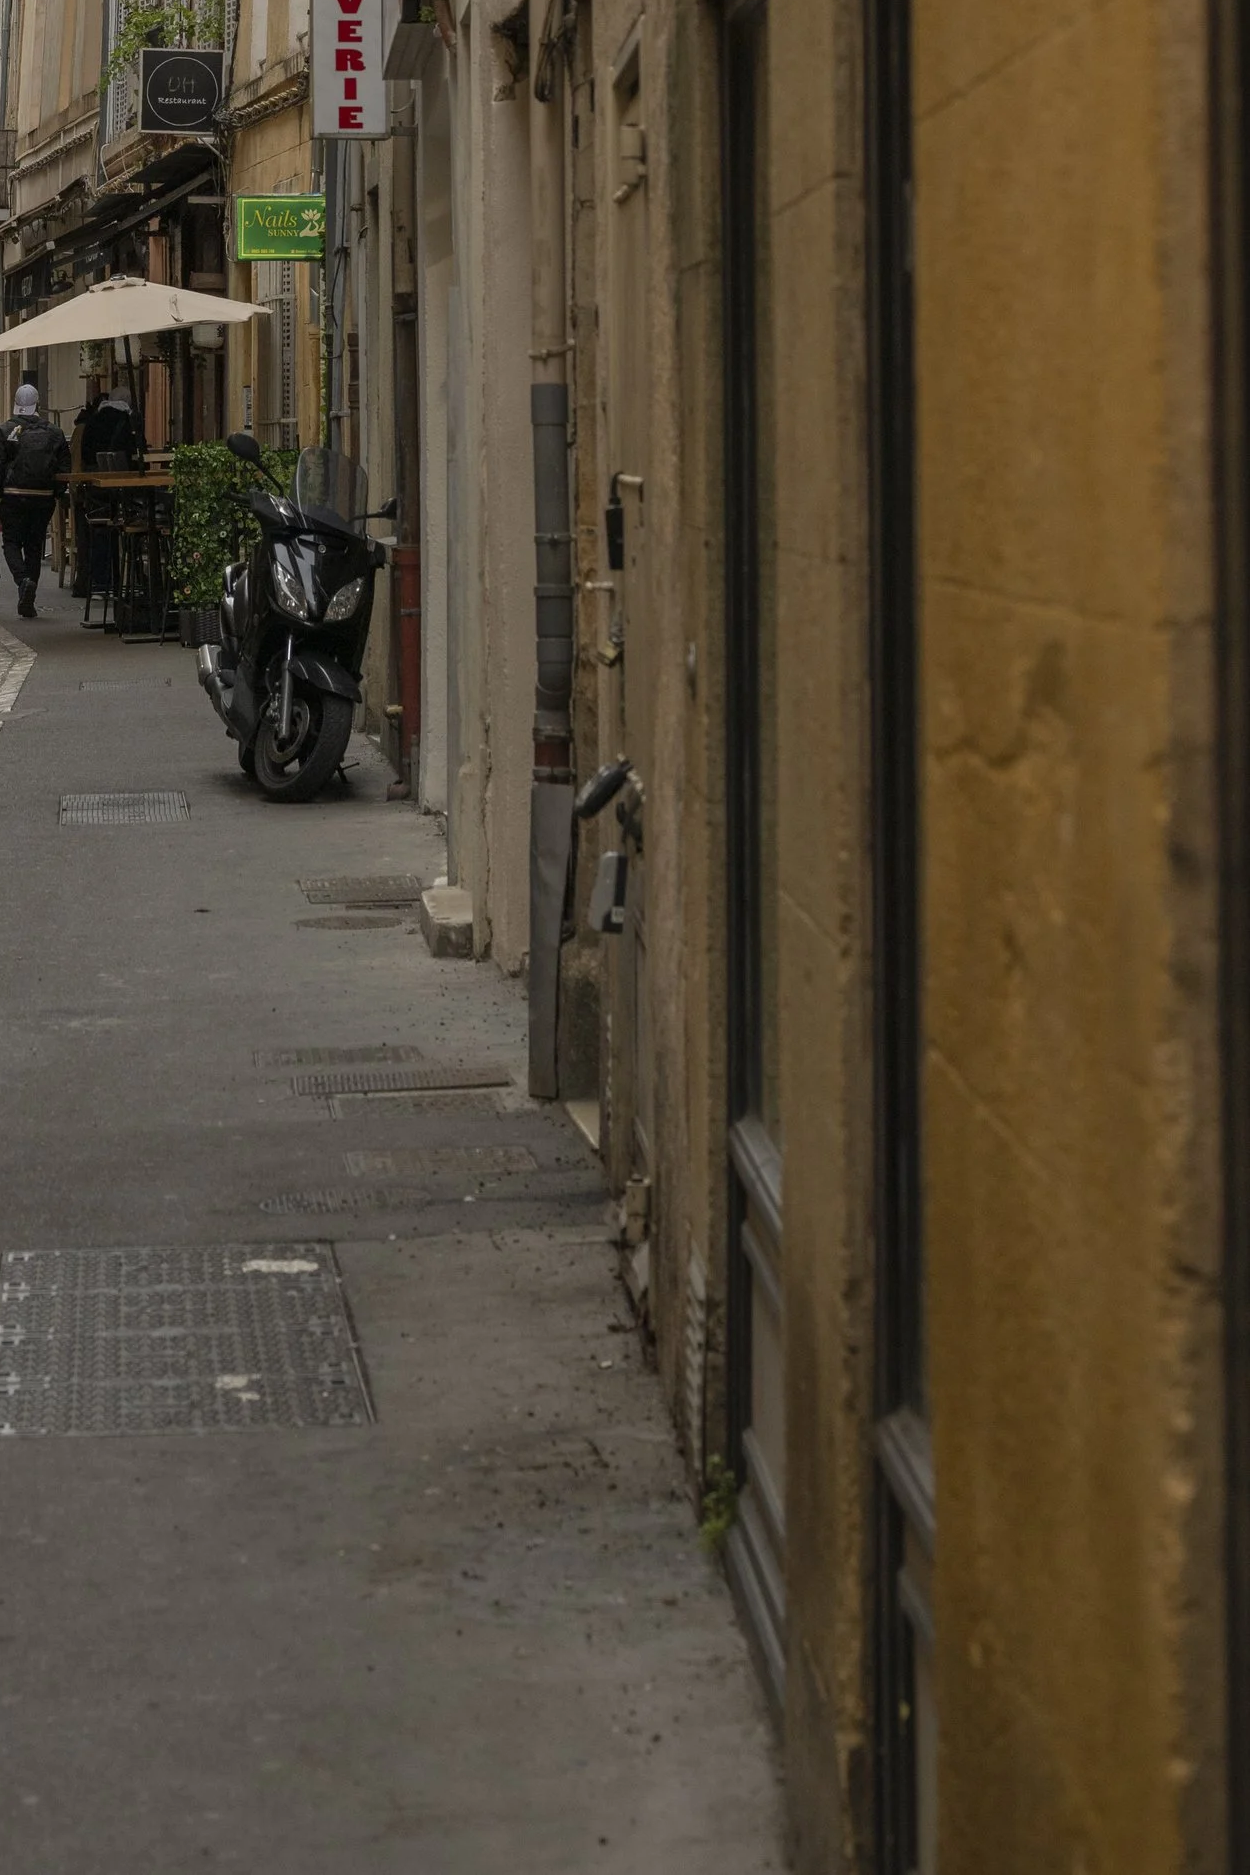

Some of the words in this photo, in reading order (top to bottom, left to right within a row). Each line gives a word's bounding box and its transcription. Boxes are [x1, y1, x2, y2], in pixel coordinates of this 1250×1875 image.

[157, 97, 207, 105] Restaurant
[245, 205, 298, 227] Nails
[268, 229, 300, 237] SUNNY
